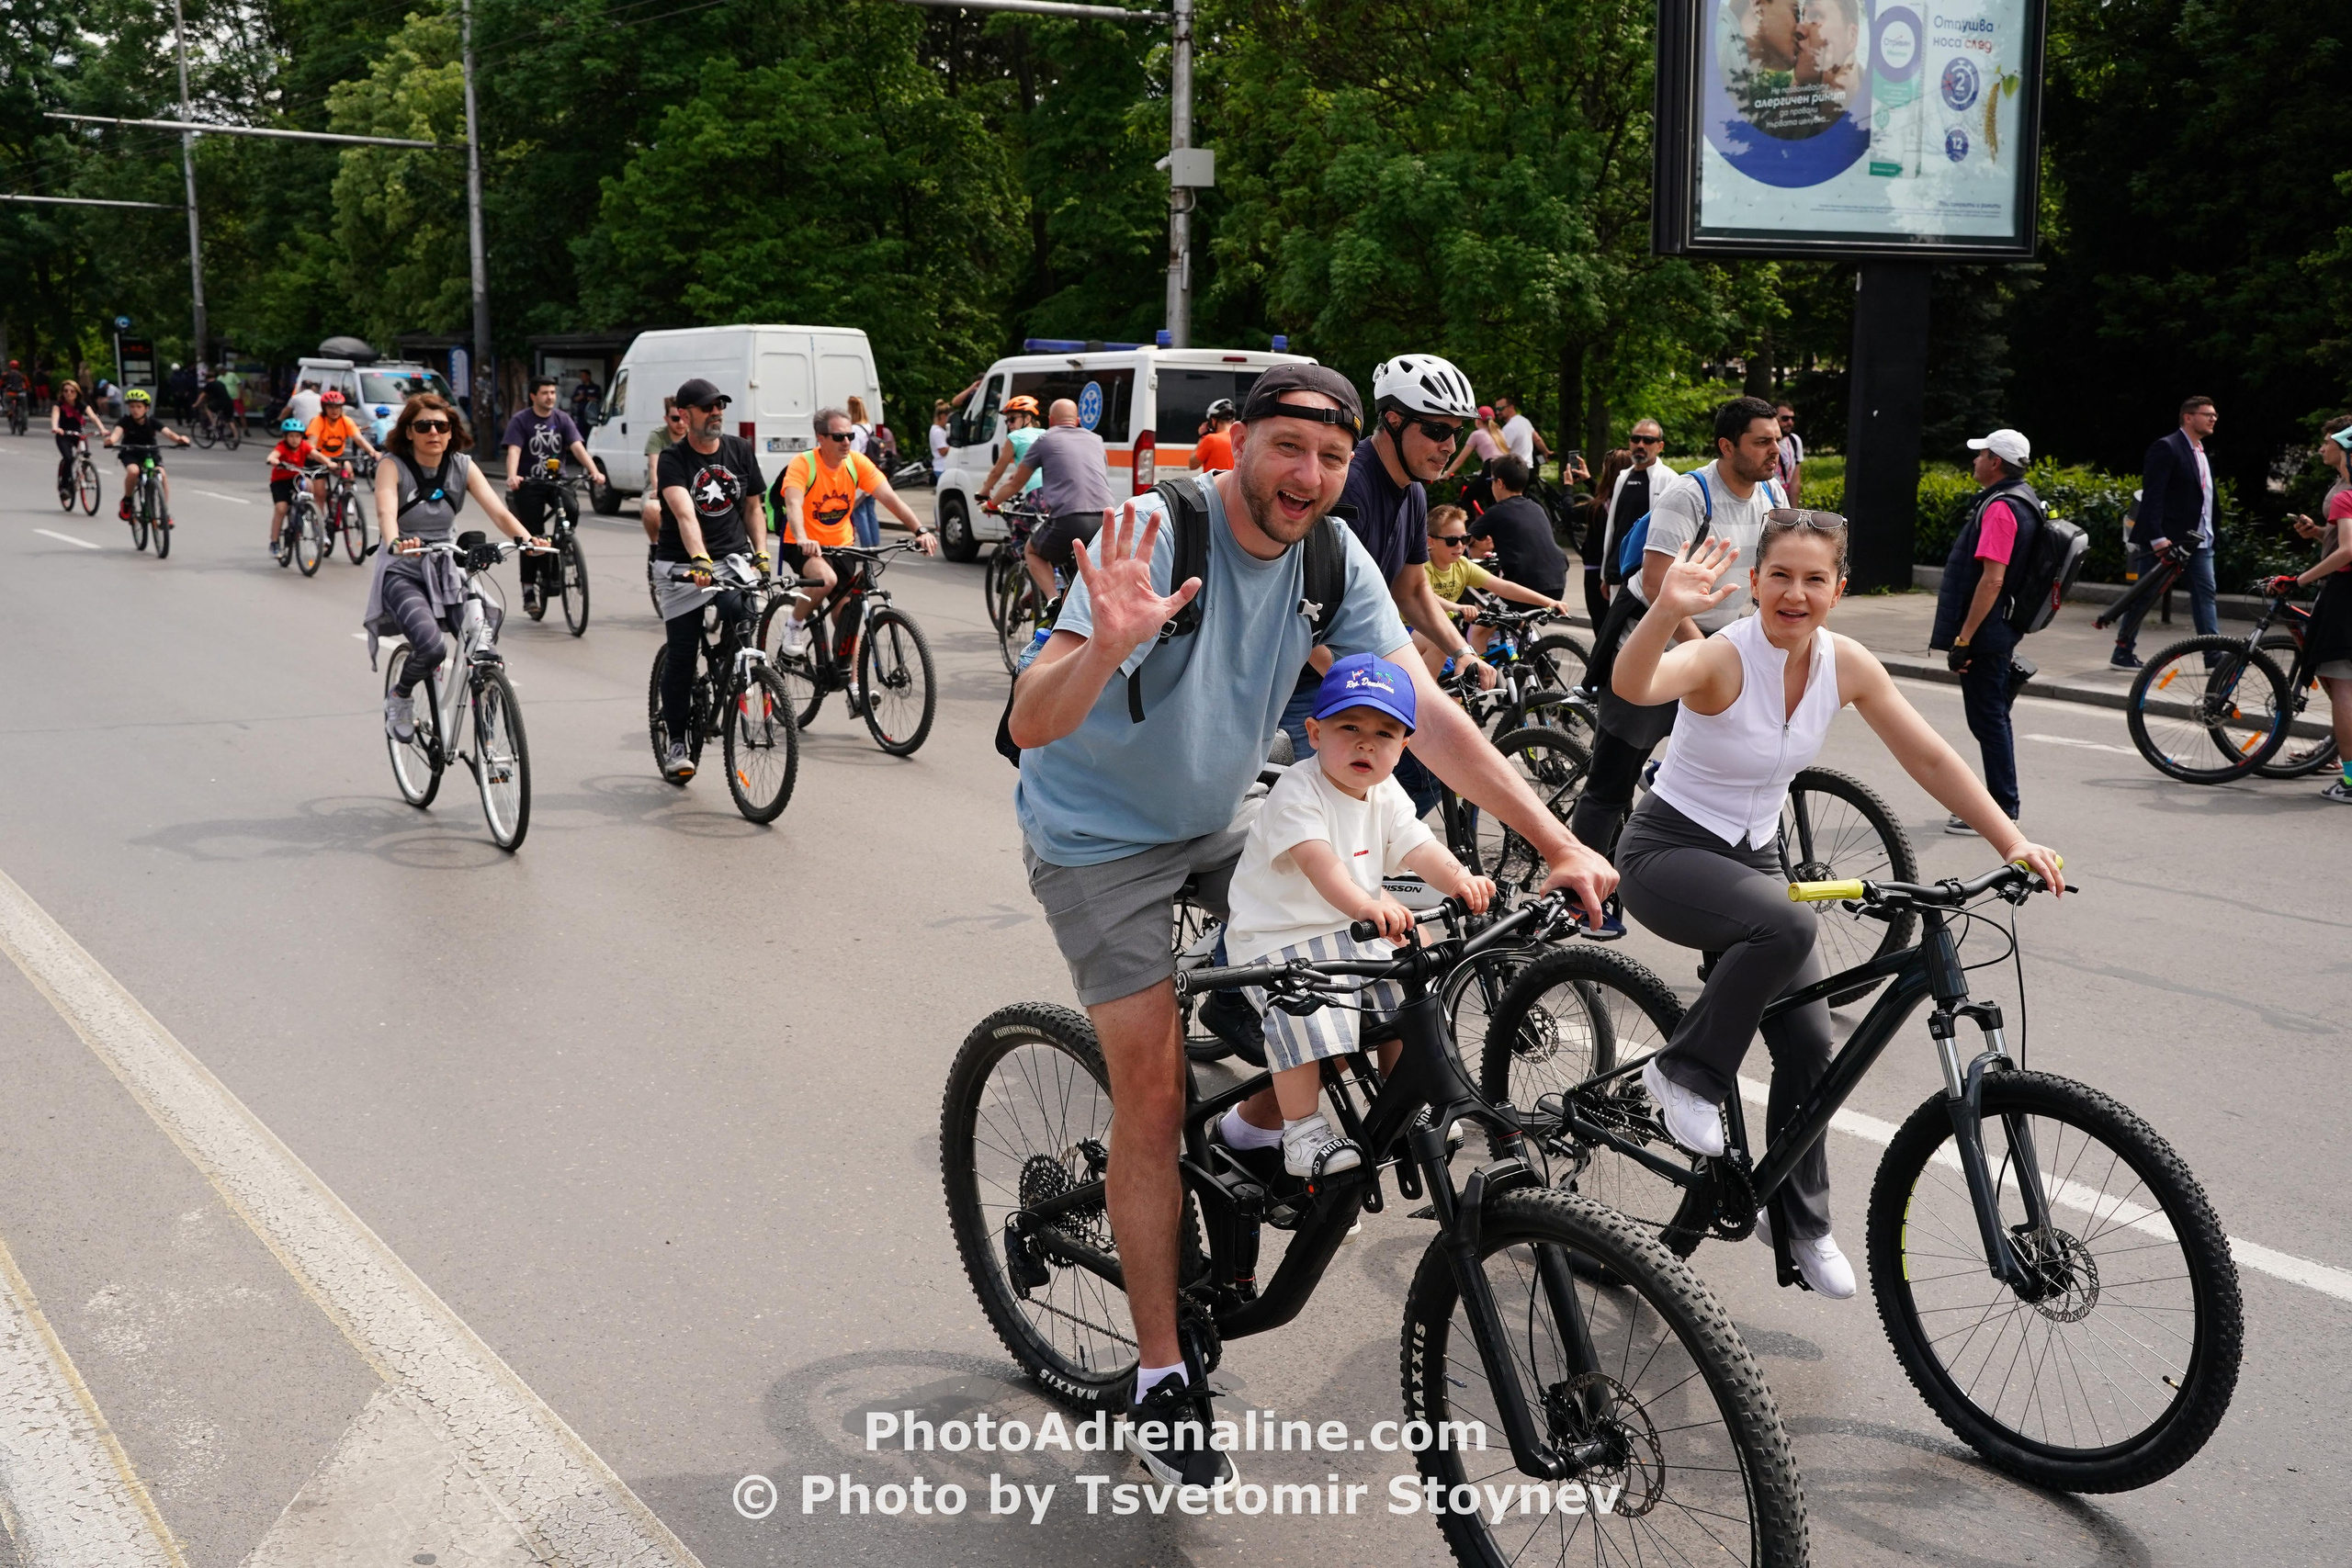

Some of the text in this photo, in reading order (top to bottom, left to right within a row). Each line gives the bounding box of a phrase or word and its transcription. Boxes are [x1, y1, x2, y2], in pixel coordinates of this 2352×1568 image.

[1934, 15, 1994, 33] Отпушва
[1933, 37, 1992, 53] носа след
[1955, 73, 1965, 91] 2
[1754, 91, 1847, 109] алергичен ринит
[1951, 137, 1962, 151] 12
[992, 1024, 1043, 1040] FOREKASTER
[1412, 1321, 1426, 1425] MAXXIS
[1039, 1369, 1100, 1401] MAXXIS
